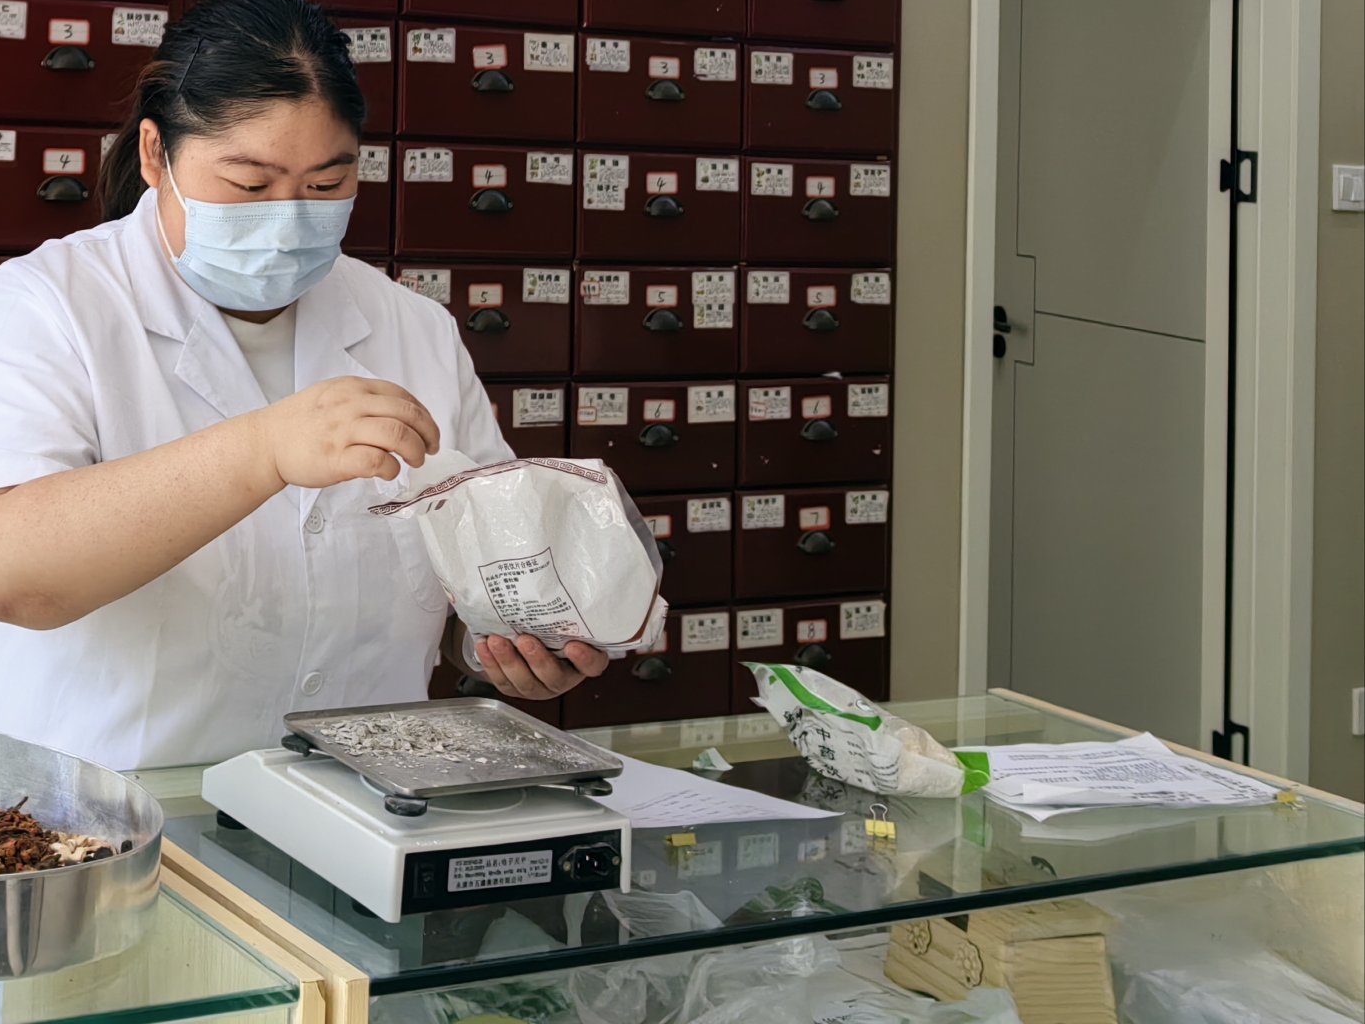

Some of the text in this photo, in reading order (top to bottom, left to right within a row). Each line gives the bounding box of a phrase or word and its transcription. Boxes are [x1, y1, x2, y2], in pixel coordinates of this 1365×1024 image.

[64, 23, 74, 40] 3
[485, 51, 495, 65] 3
[660, 61, 669, 74] 3
[59, 154, 71, 170] 4
[484, 169, 493, 185] 4
[656, 176, 667, 192] 4
[480, 290, 489, 304] 5
[657, 291, 666, 304] 5
[654, 402, 662, 419] 6
